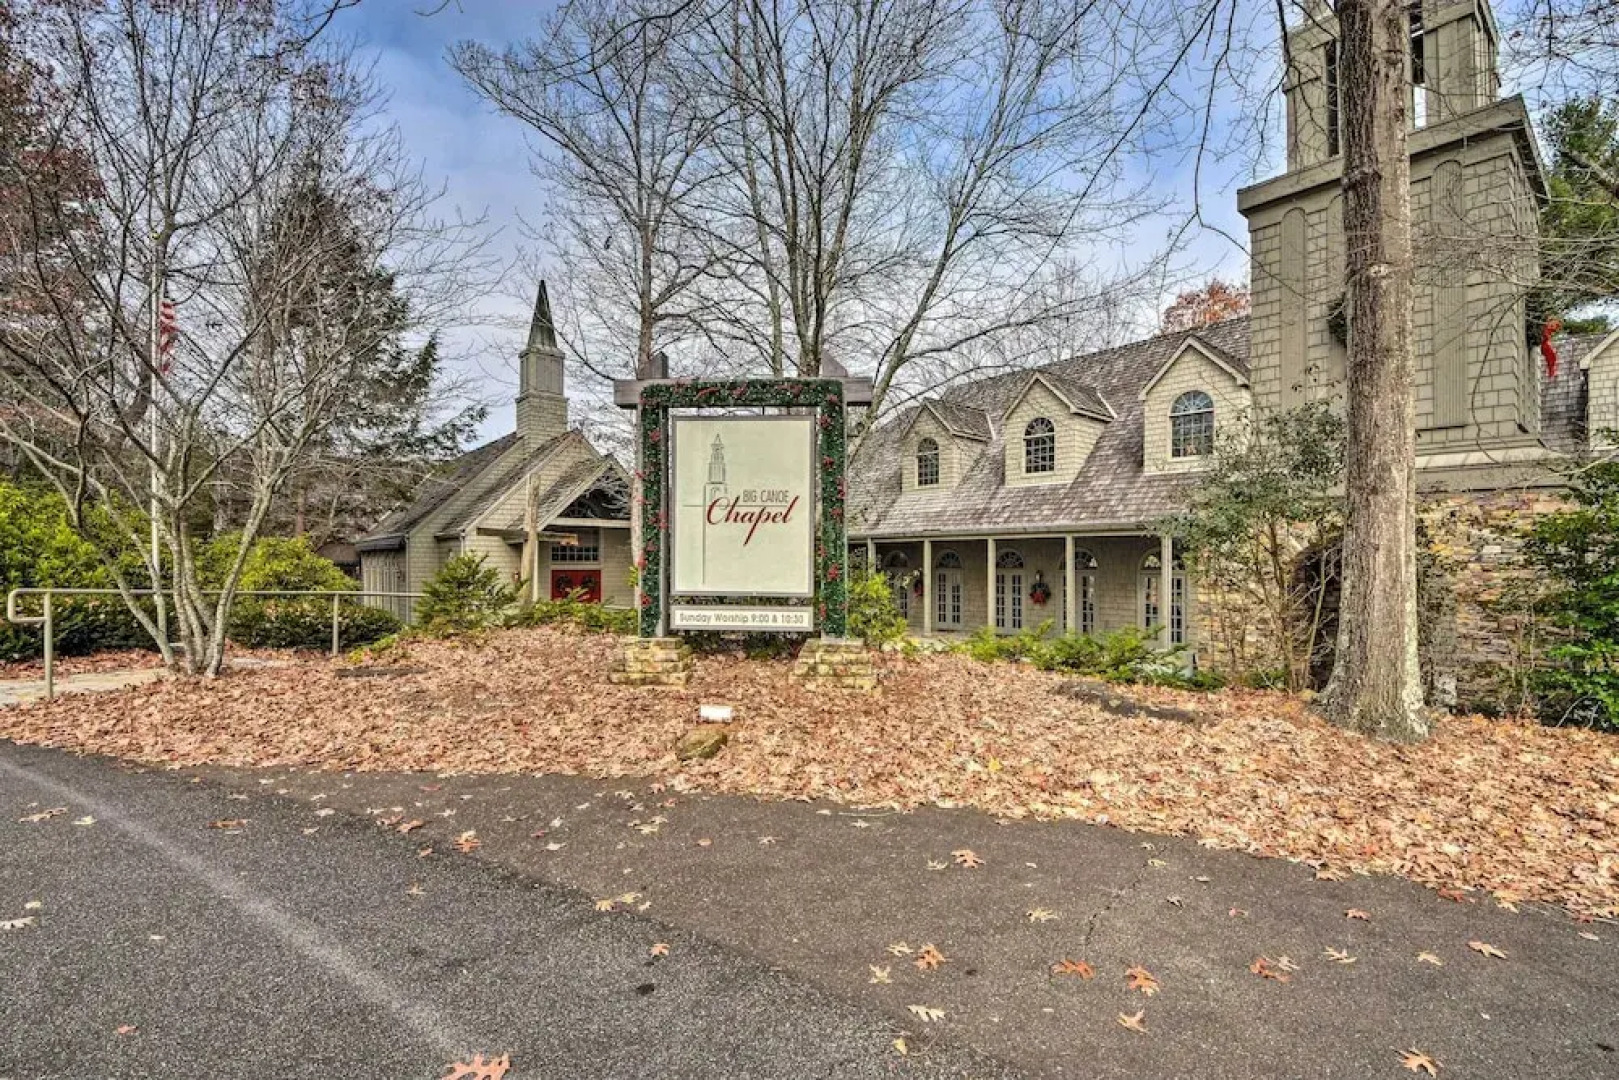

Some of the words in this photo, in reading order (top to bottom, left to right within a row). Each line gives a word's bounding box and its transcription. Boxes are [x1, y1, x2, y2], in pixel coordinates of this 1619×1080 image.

[743, 489, 757, 503] BIG
[761, 489, 789, 503] CANOE
[707, 495, 799, 547] Chapel
[679, 613, 712, 624] Sunday
[714, 613, 749, 624] Worship
[751, 613, 770, 624] 9:00
[781, 614, 804, 624] 10:30
